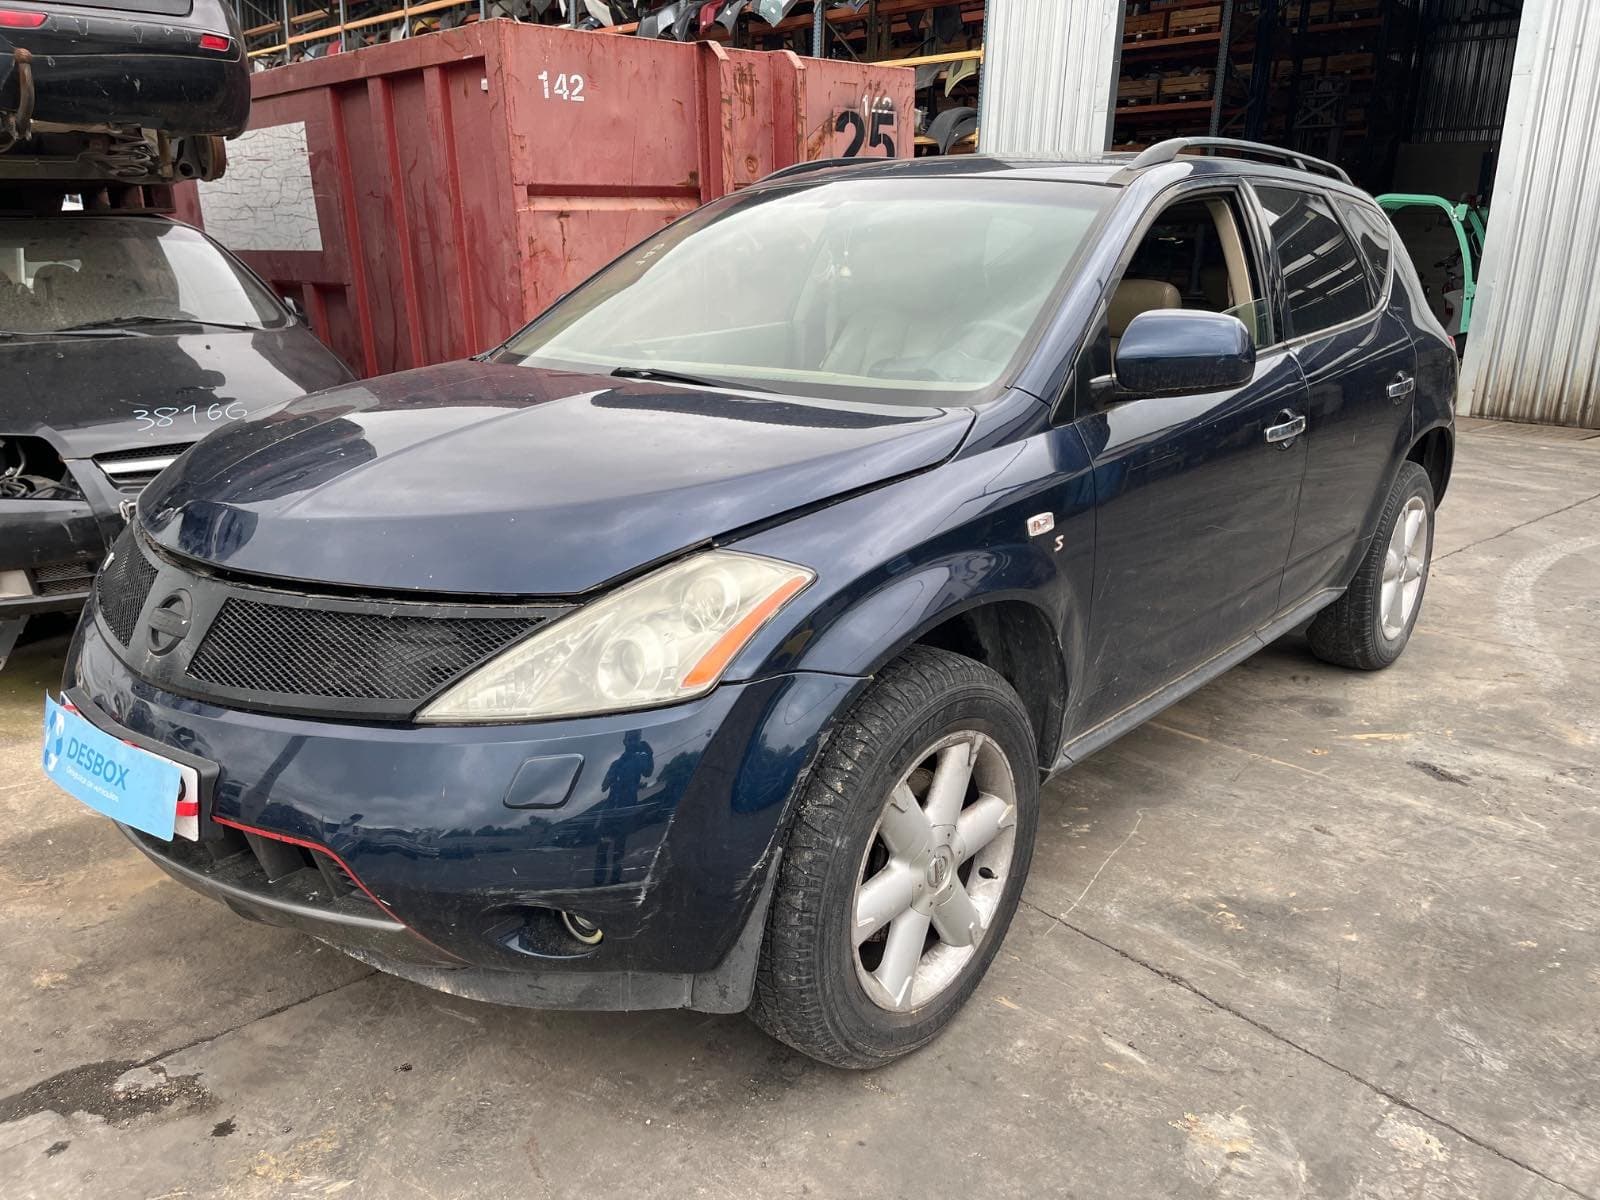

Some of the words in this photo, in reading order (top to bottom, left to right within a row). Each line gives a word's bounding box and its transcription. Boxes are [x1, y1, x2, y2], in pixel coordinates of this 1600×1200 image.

[537, 70, 585, 102] 142
[835, 110, 896, 158] 25
[66, 737, 131, 792] DESBOX
